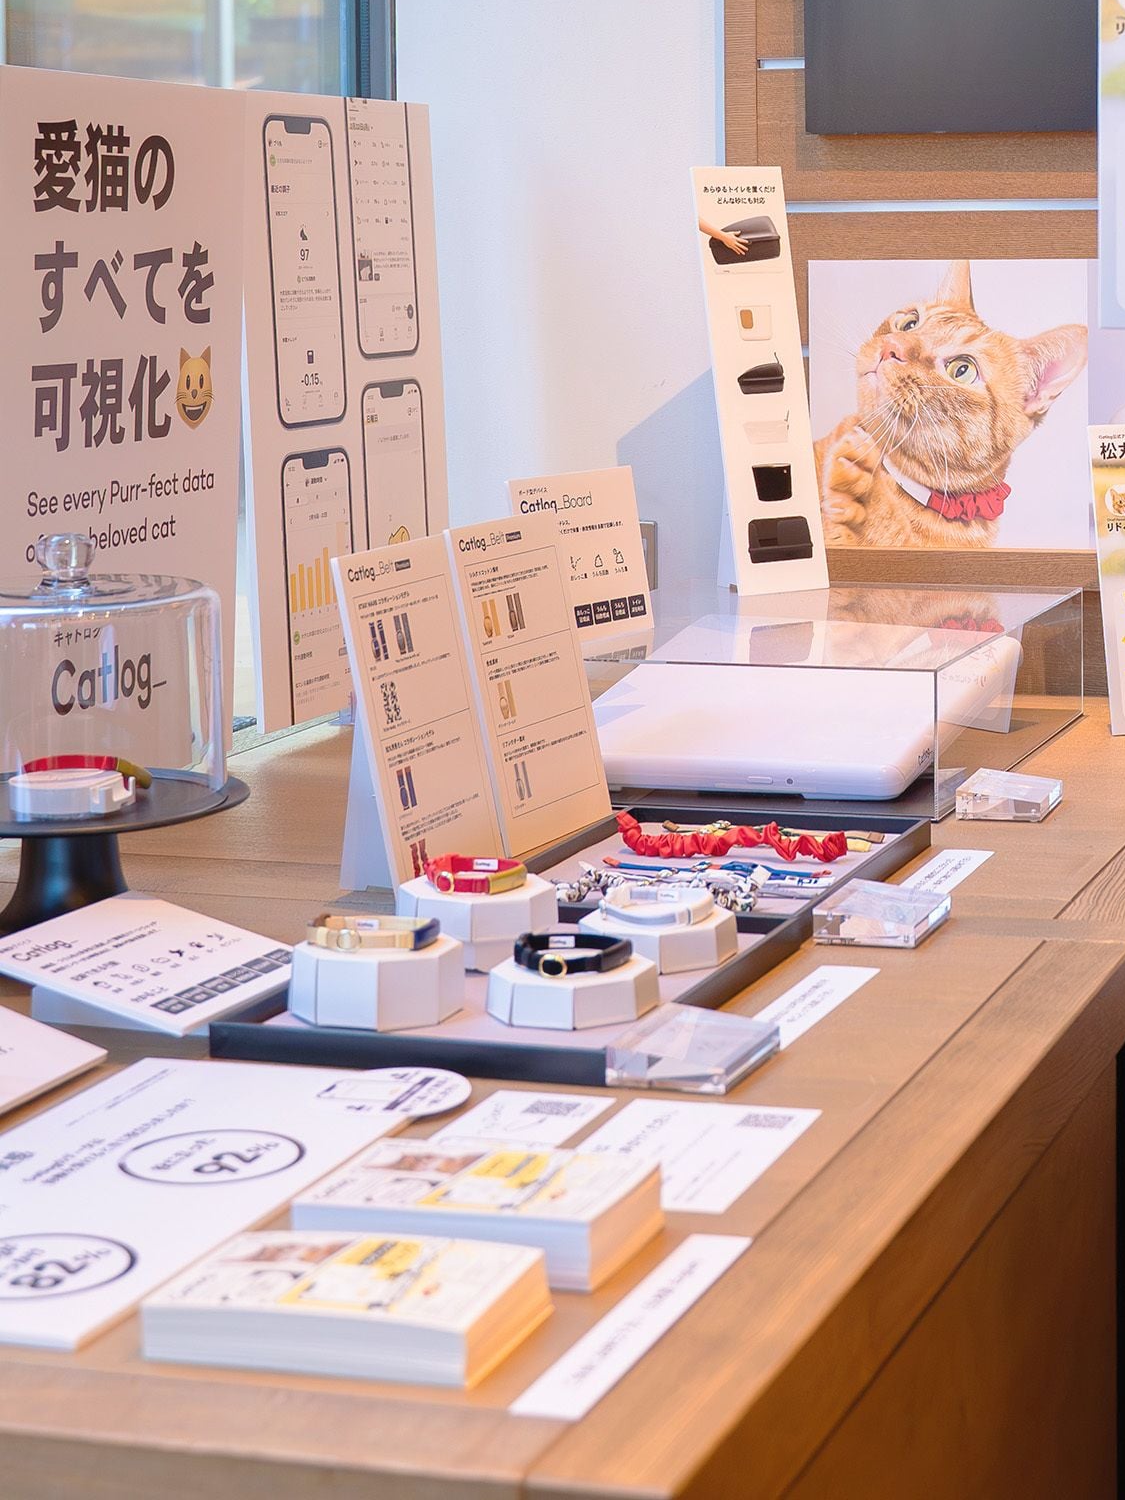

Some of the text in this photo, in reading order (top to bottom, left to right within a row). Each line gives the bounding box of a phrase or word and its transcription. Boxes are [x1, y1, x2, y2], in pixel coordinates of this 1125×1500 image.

[33, 116, 175, 213] 愛猫の
[34, 240, 215, 334] すべてを
[300, 248, 310, 261] 97
[31, 353, 173, 453] 可視化
[26, 468, 215, 518] See every Purr-fect data
[89, 517, 148, 550] beloved
[151, 514, 176, 540] cat
